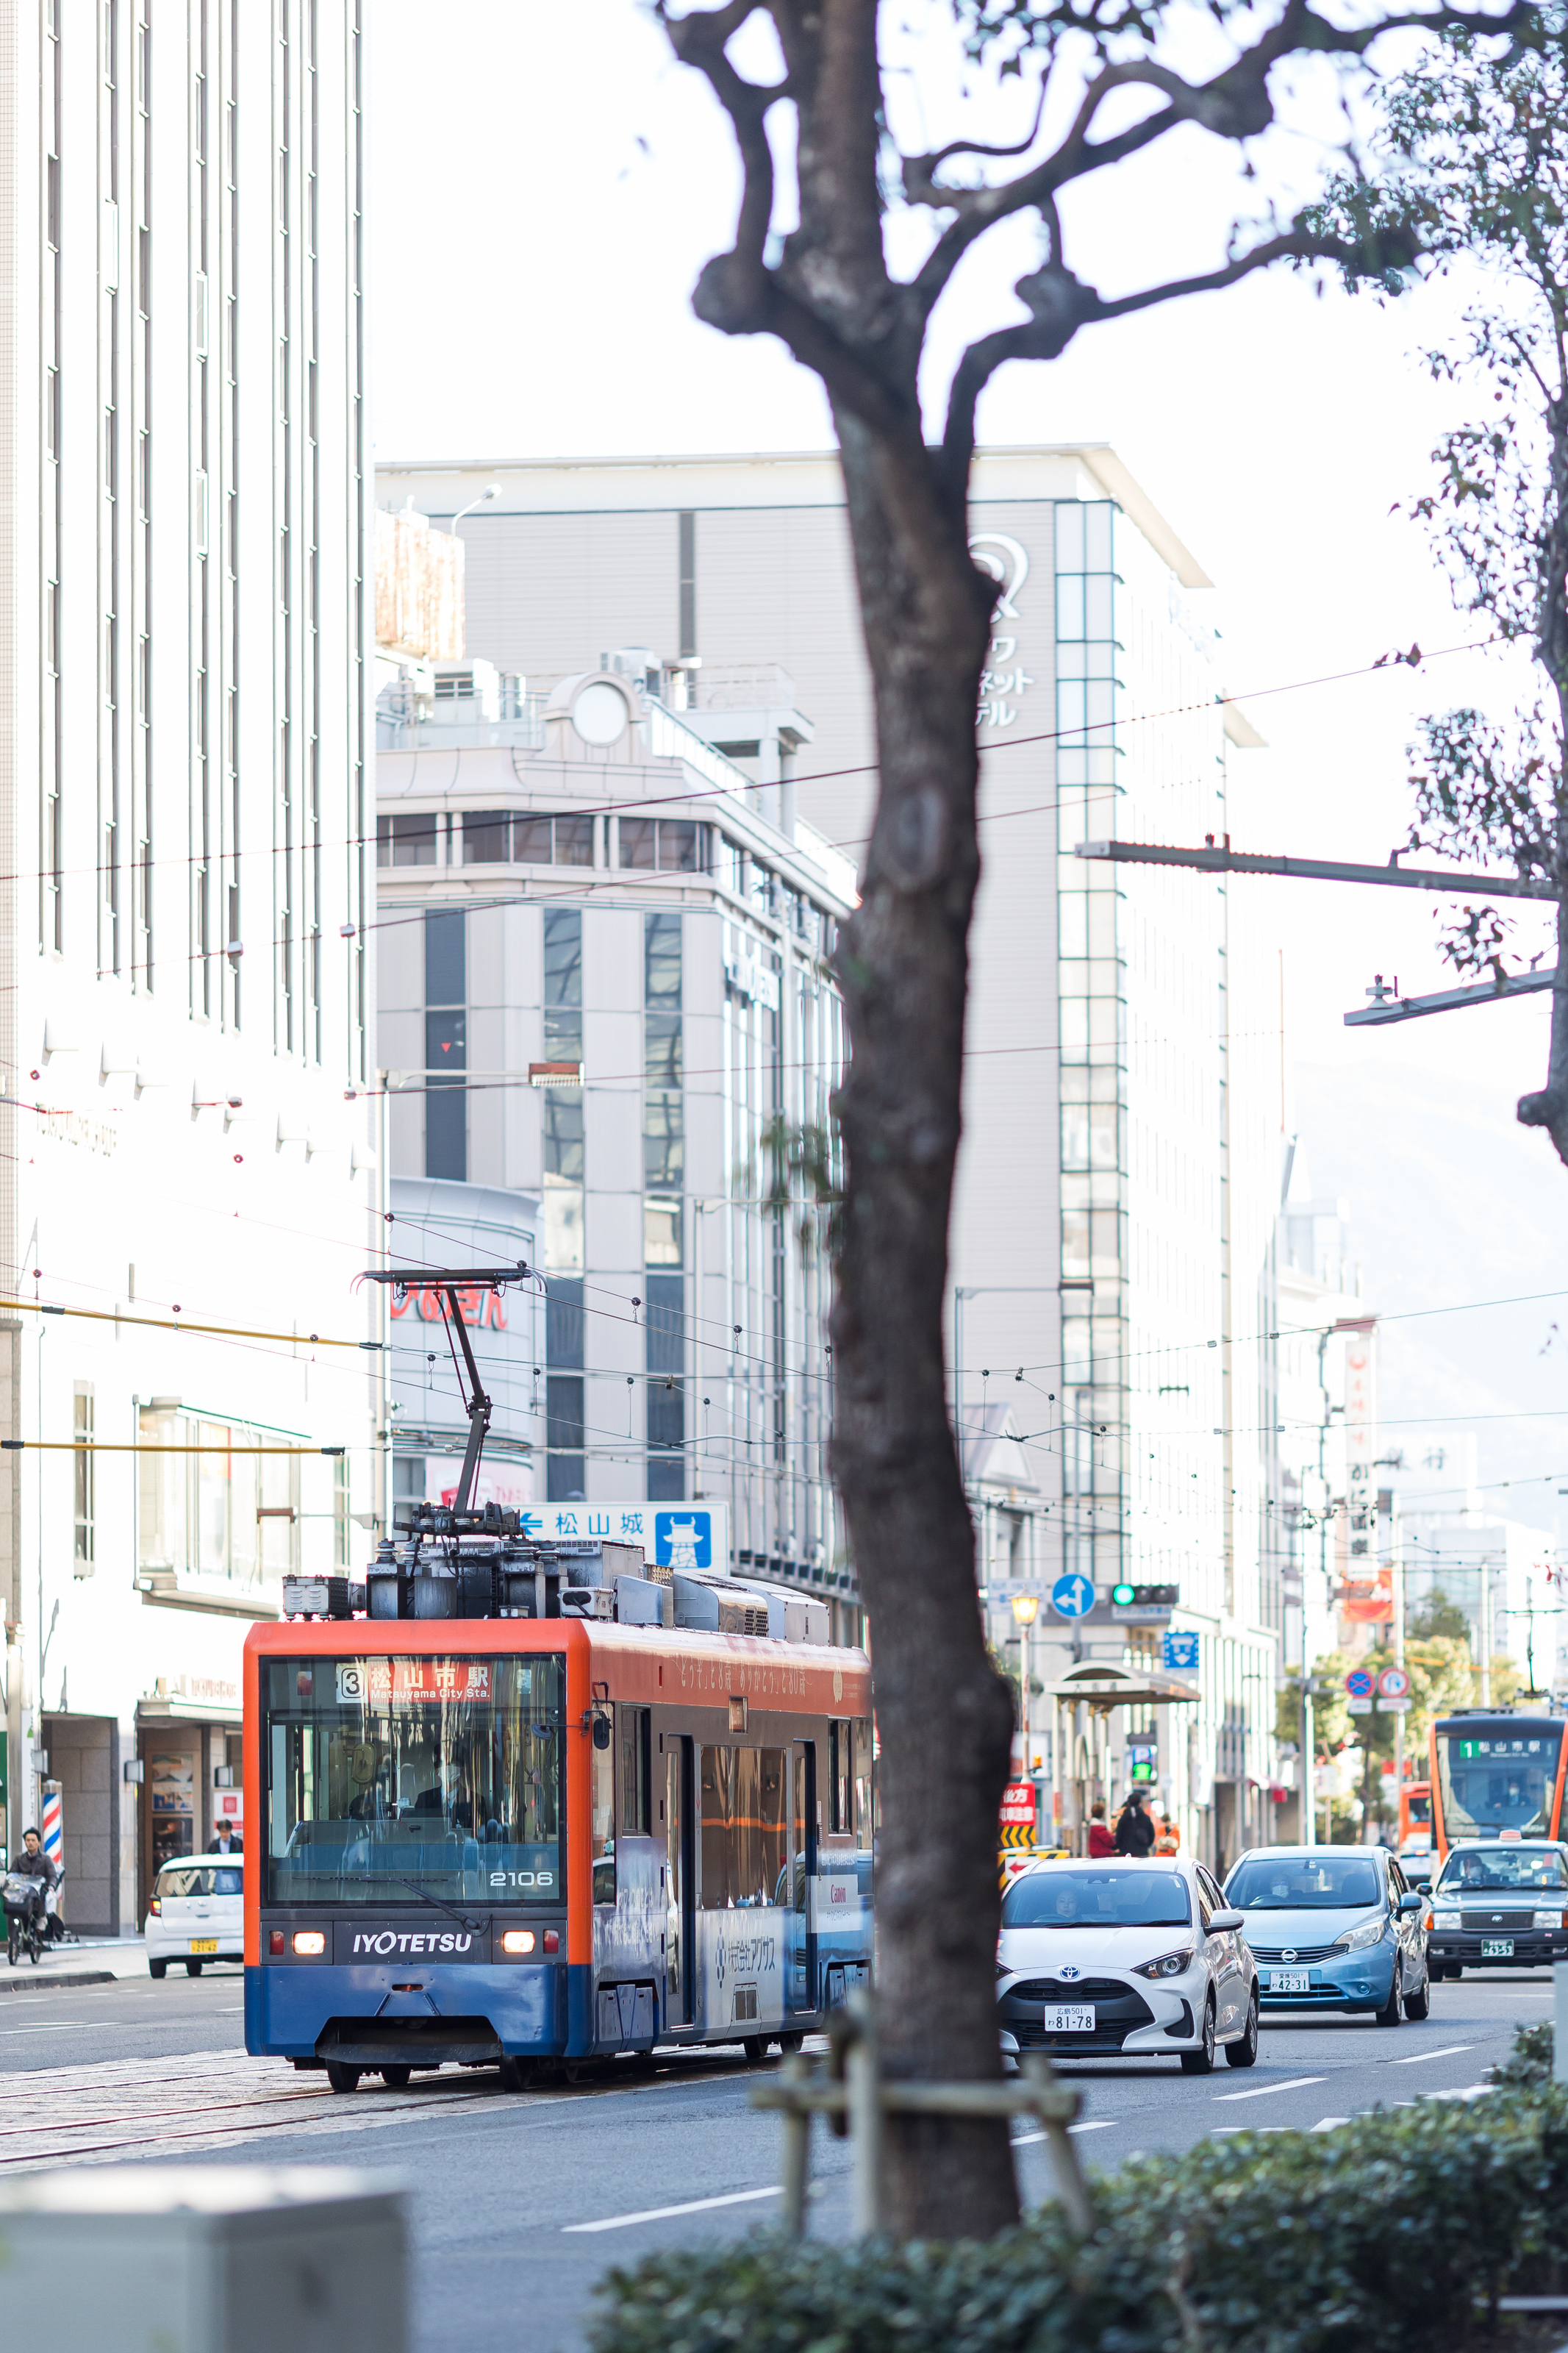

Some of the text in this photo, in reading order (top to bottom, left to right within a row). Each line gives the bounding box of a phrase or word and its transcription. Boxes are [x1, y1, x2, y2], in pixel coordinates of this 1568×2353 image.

[556, 1513, 644, 1535] 松山城
[346, 1671, 360, 1695] 3
[370, 1666, 489, 1689] 松山市駅
[370, 1688, 490, 1699] Matsuyama City Sta.
[1464, 1741, 1472, 1758] 1
[1478, 1740, 1541, 1753] 松山市駅
[1003, 1788, 1028, 1803] 後方
[490, 1871, 554, 1887] 2106
[830, 1884, 846, 1904] Canon
[353, 1931, 472, 1954] IYOTETSU
[1489, 1945, 1513, 1955] 63-53
[728, 1935, 776, 1974] 株式会社アグサス
[1278, 1979, 1309, 1990] 42-31
[1056, 2007, 1084, 2015] 広島501
[1048, 2015, 1092, 2029] わ 81-78
